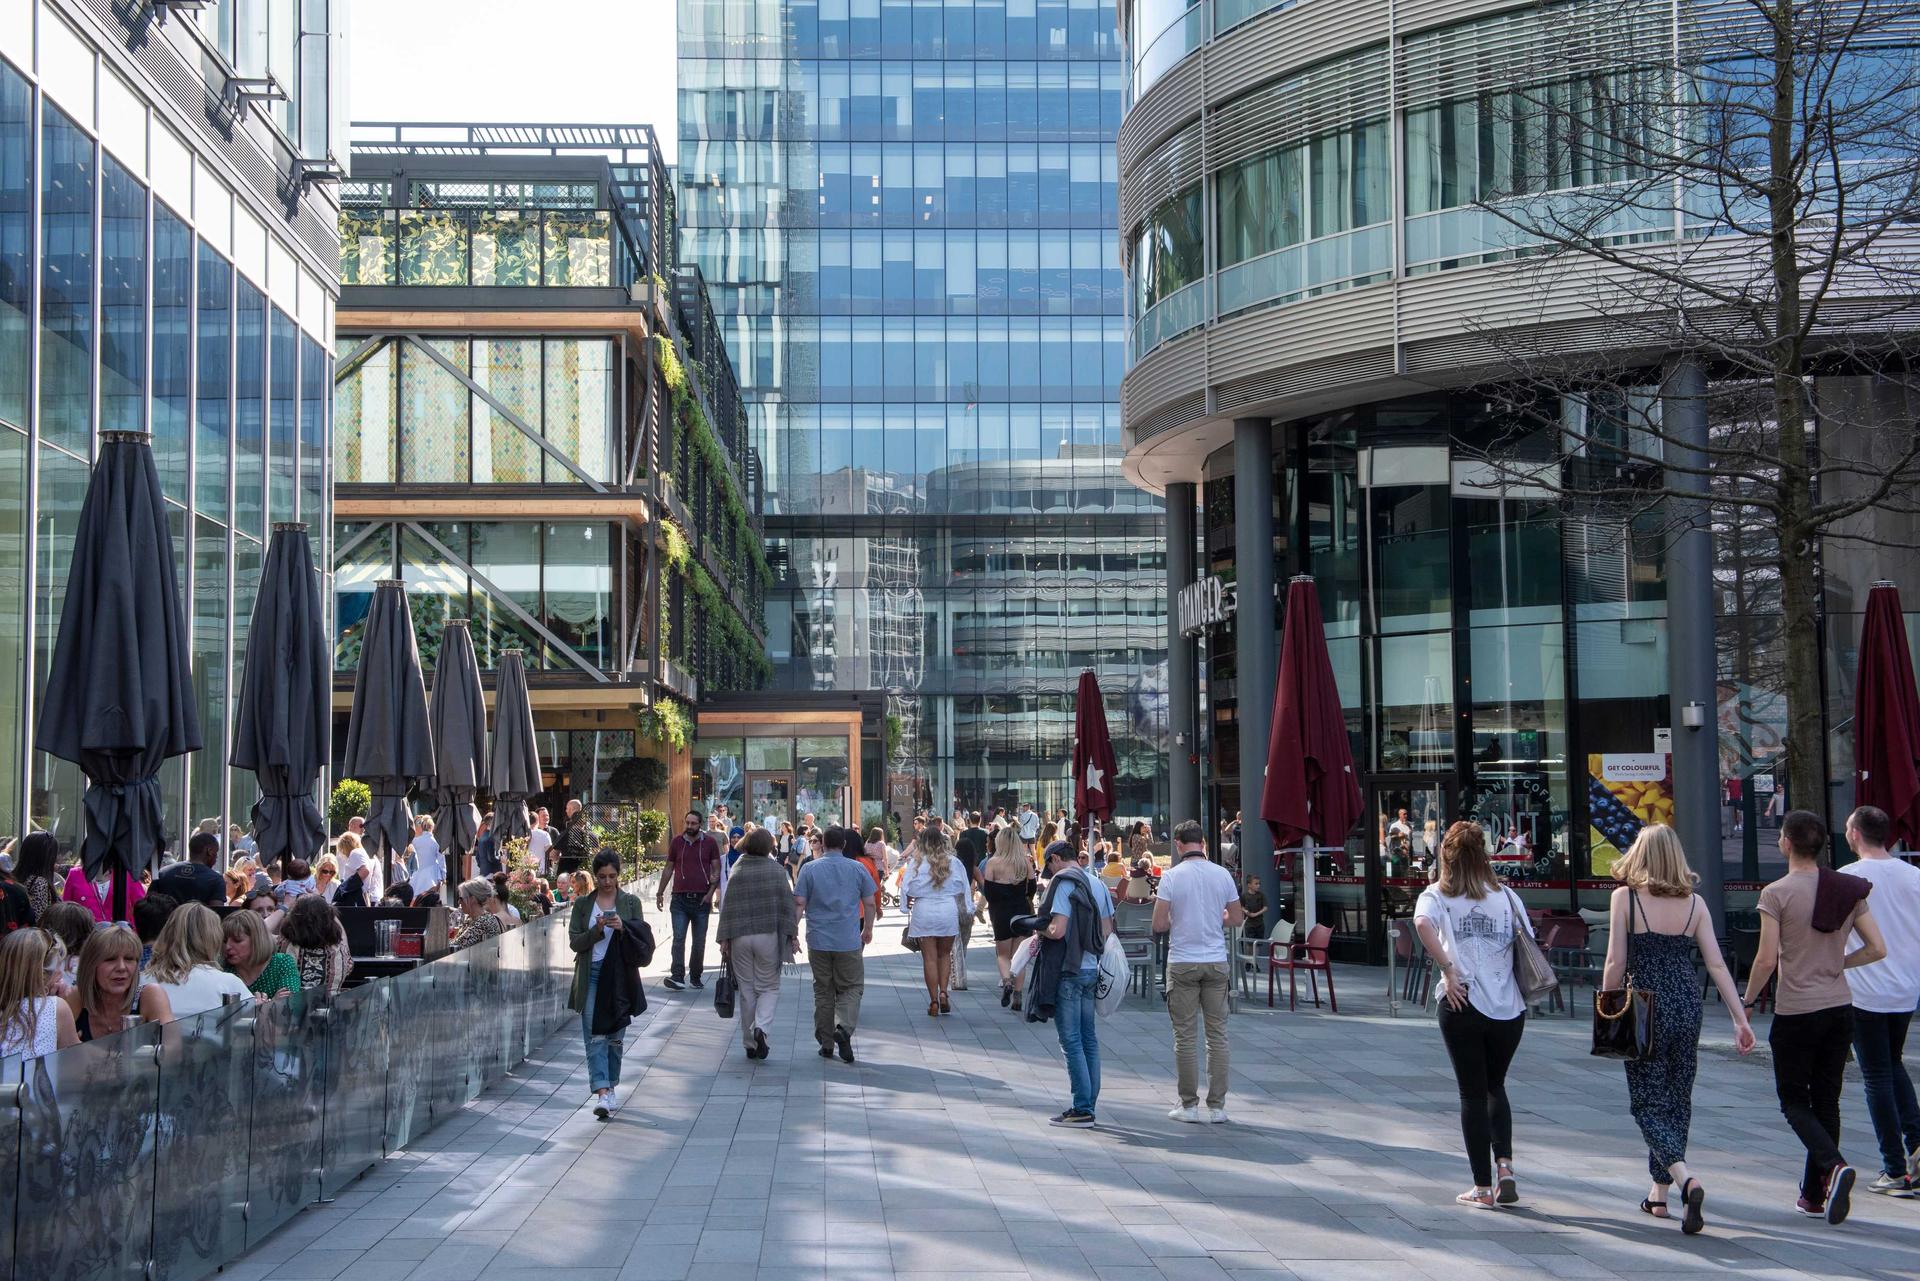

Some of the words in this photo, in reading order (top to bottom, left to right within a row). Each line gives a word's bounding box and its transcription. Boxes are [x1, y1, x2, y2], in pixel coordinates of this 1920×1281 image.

[1183, 576, 1222, 630] MANGER
[1523, 779, 1563, 823] COFFEE
[1534, 840, 1561, 872] FOOD
